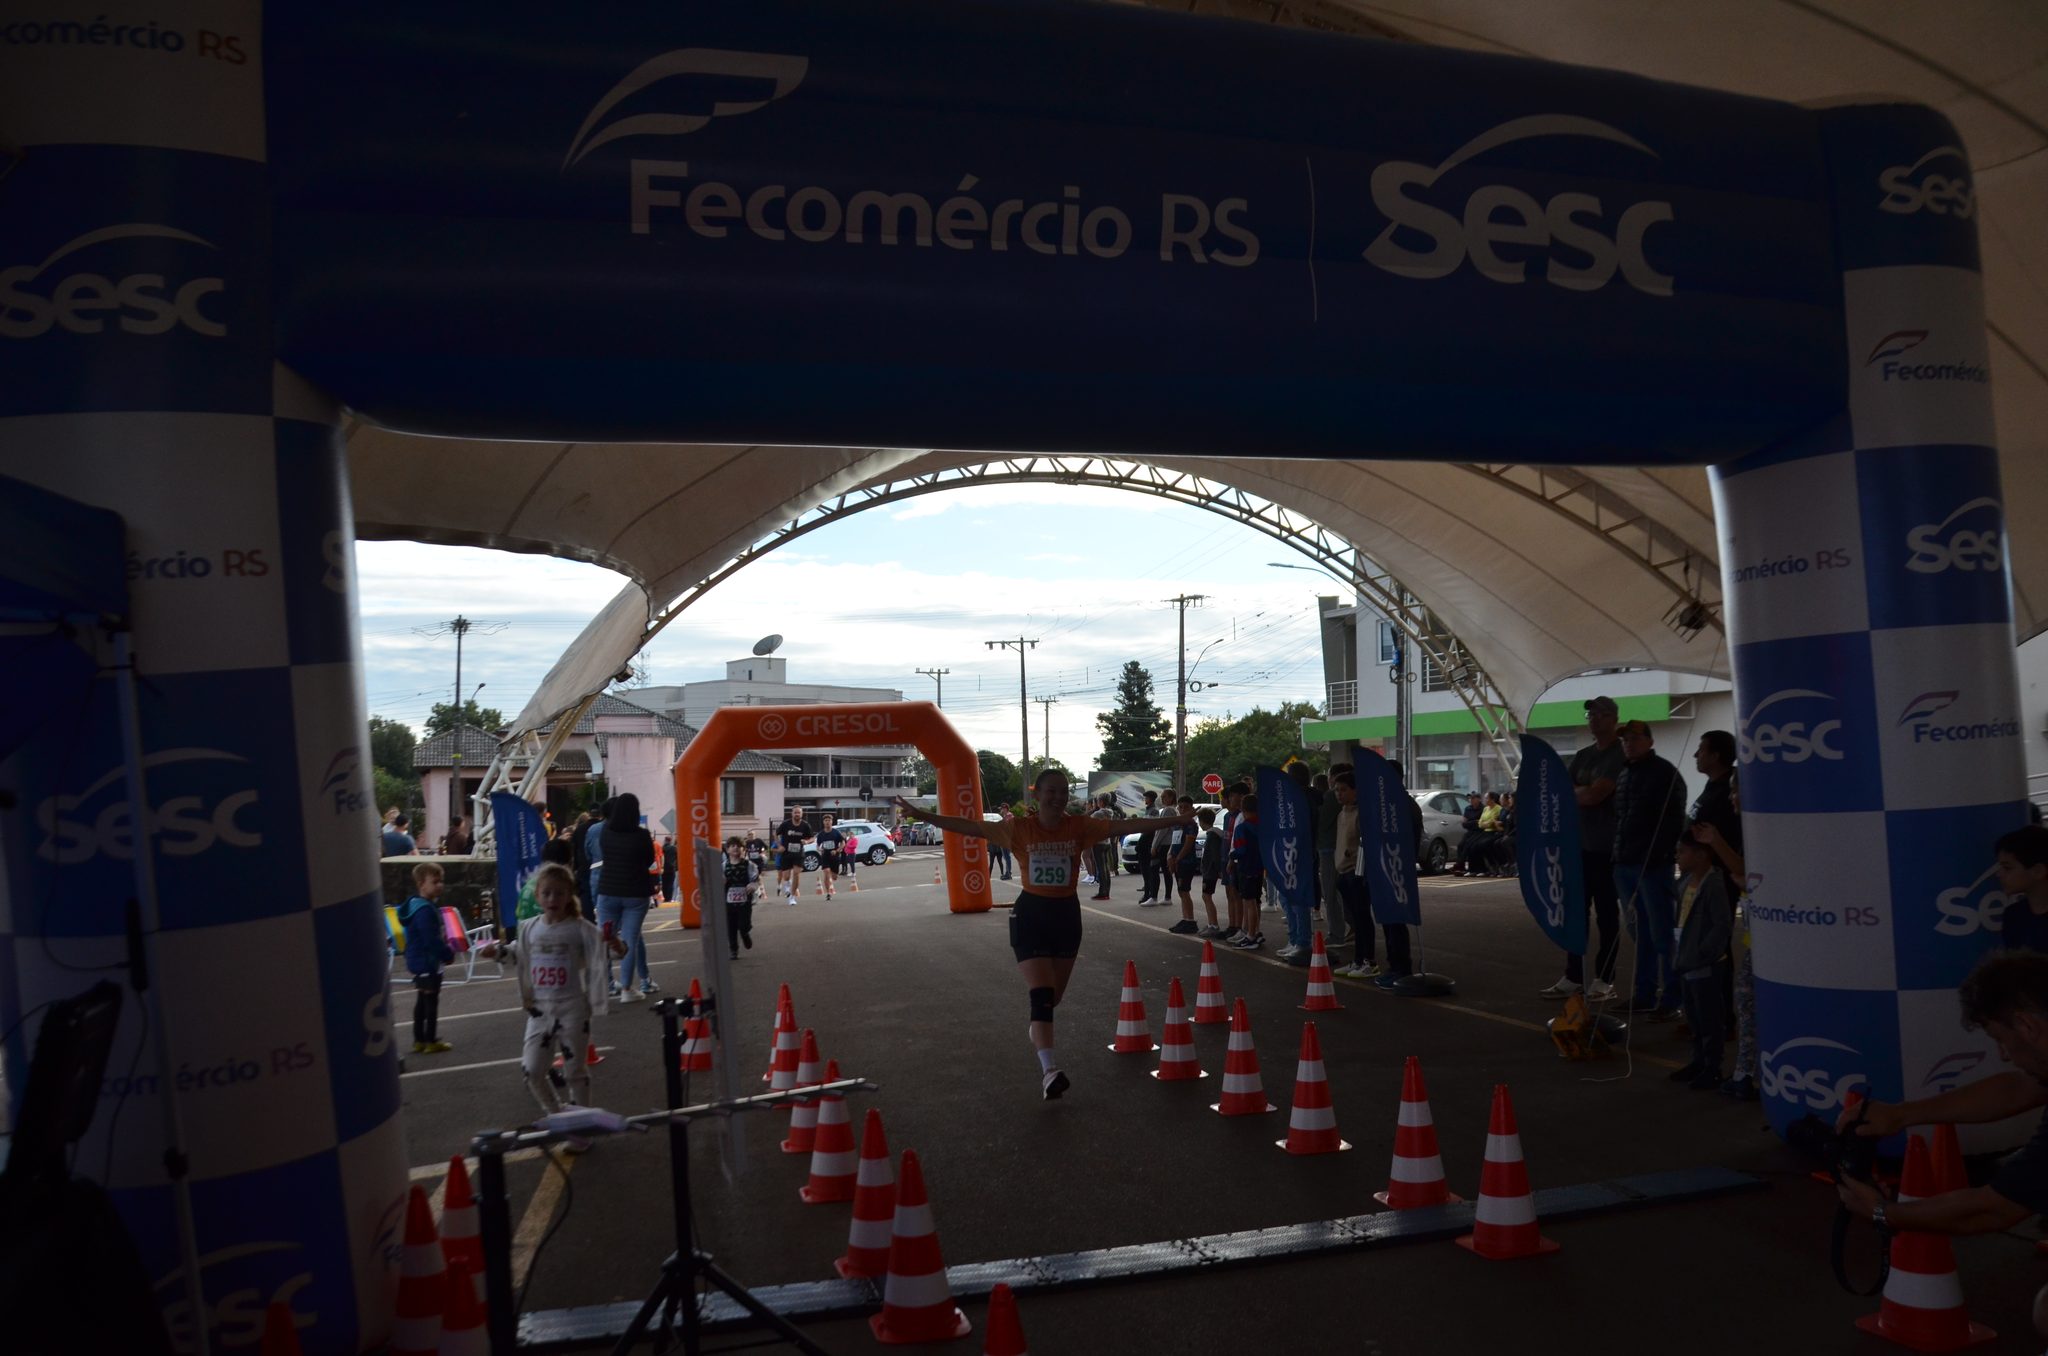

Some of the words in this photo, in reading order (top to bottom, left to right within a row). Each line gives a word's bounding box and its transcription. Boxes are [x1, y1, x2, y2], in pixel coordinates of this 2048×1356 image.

[0, 15, 185, 53] comércio
[198, 30, 248, 65] RS
[630, 157, 1133, 259] Fecomércio
[1159, 192, 1261, 267] RS
[126, 550, 211, 580] ércio
[223, 549, 269, 578] RS
[1816, 548, 1851, 570] RS
[796, 713, 899, 736] CRESOL
[958, 777, 981, 863] CRSOL
[1034, 867, 1065, 884] 259
[1845, 907, 1879, 926] RS
[1934, 883, 2004, 936] Se
[100, 1058, 260, 1096] comércio
[271, 1042, 315, 1076] RS
